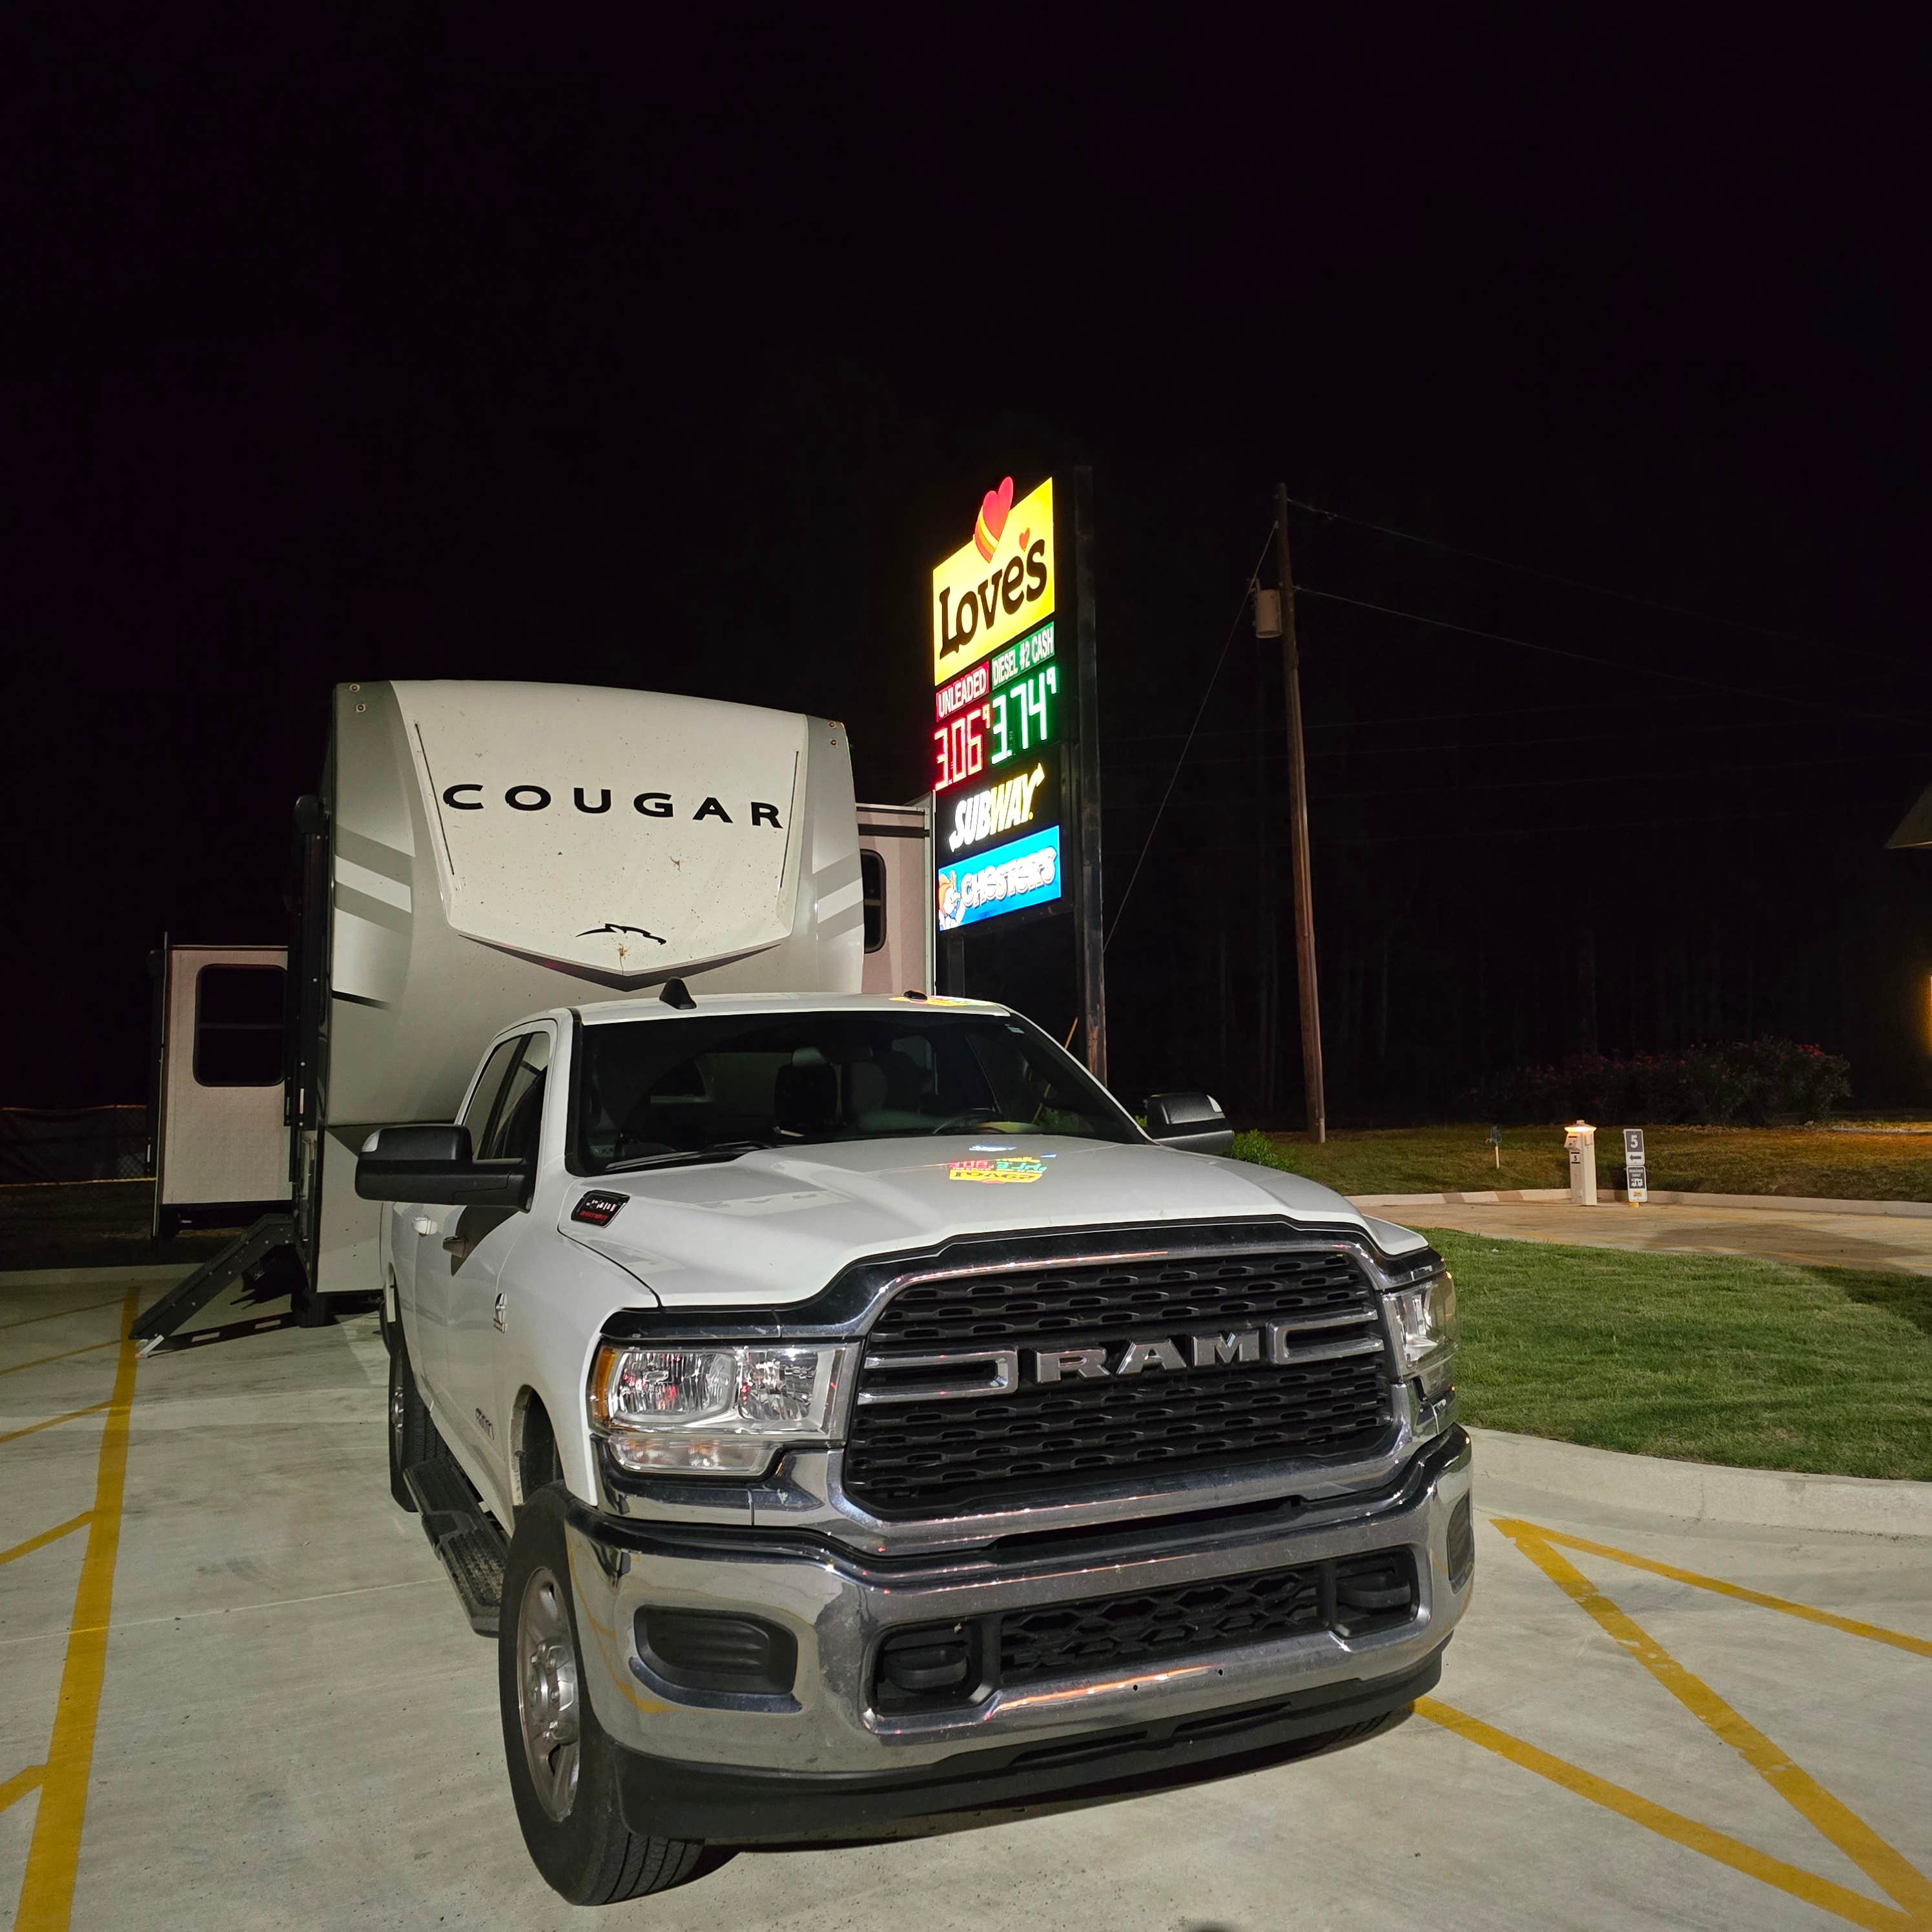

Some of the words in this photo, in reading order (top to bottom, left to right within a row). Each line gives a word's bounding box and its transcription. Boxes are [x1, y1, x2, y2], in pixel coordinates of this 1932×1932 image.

[992, 649, 1018, 687] DIESEL
[1020, 641, 1031, 670] #2
[1031, 625, 1055, 663] CASH
[938, 668, 987, 718] UNLEADED
[442, 783, 783, 829] COUGAR
[949, 763, 1045, 852] SUBWAY
[1630, 1135, 1639, 1149] 5
[1035, 1329, 1260, 1384] RAM
